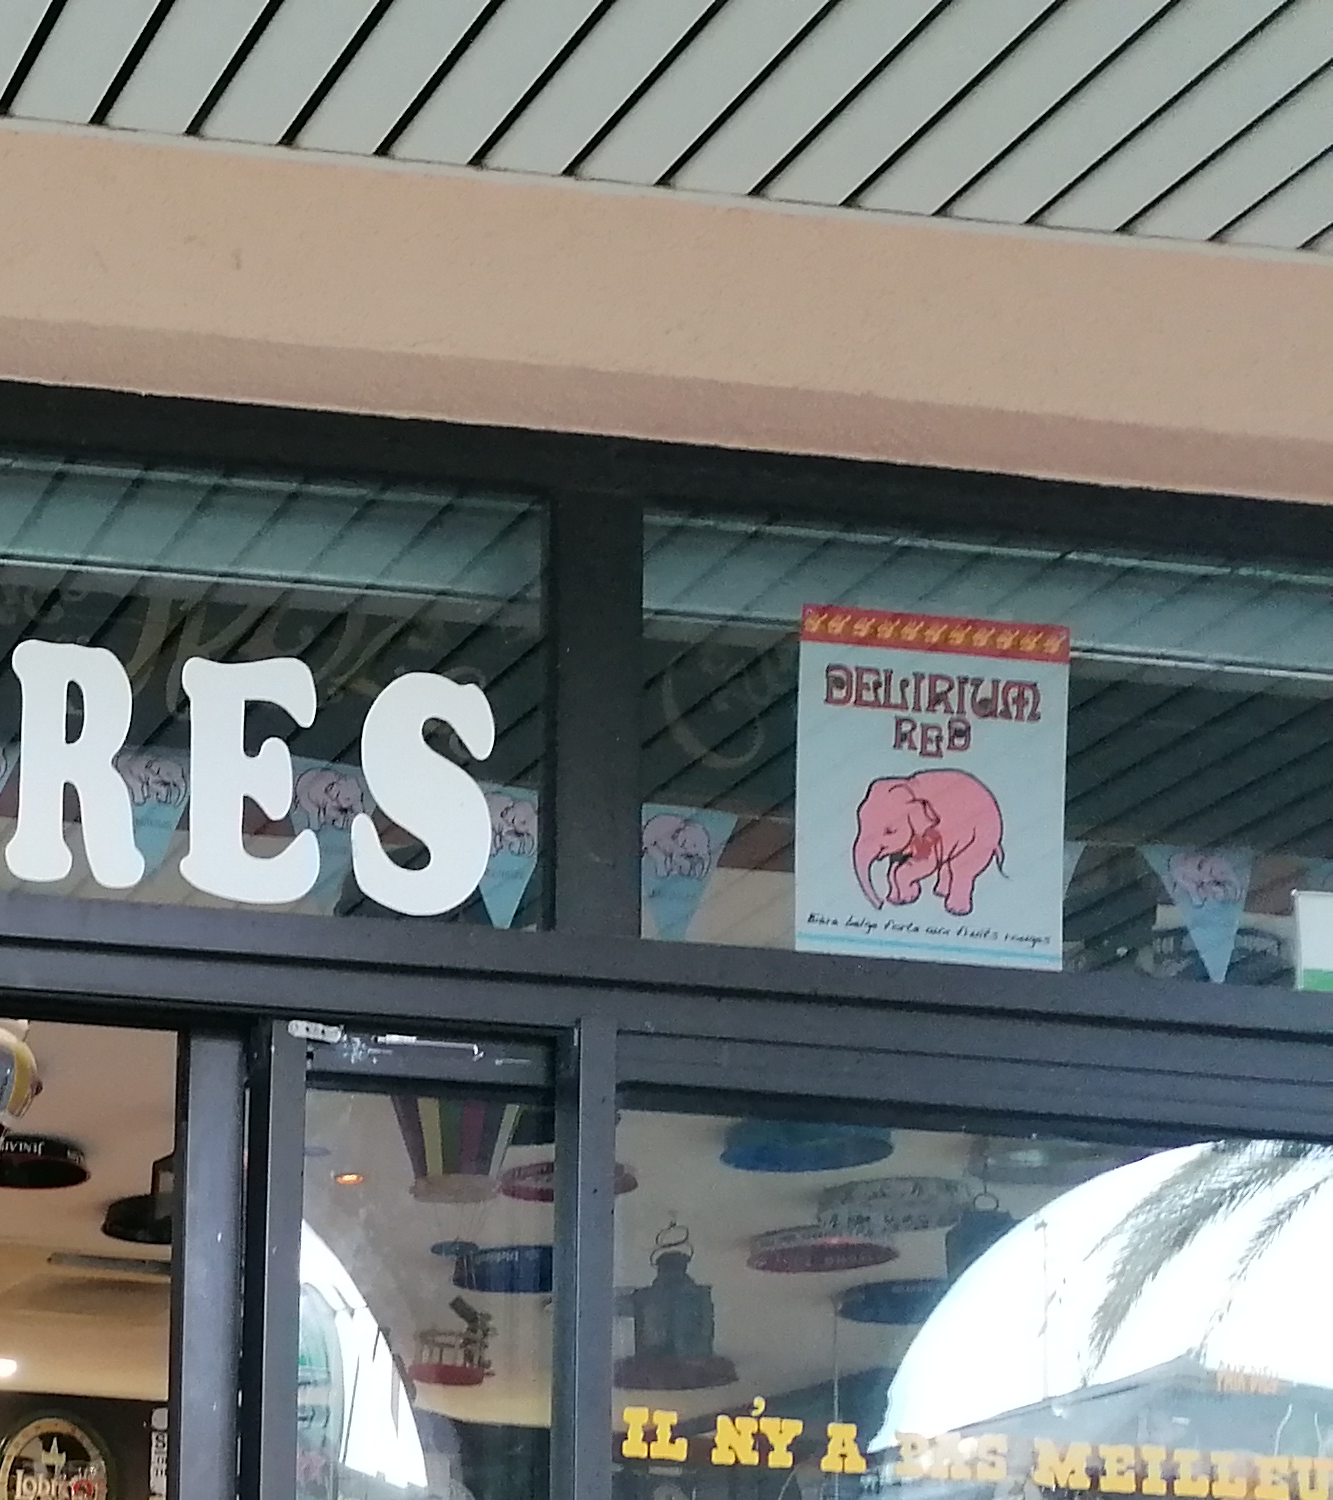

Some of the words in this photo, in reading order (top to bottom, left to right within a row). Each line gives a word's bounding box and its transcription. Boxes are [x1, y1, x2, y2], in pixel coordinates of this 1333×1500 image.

[824, 664, 1041, 722] DELIRIUM
[893, 717, 971, 758] RED
[623, 1407, 688, 1463] IL
[711, 1396, 804, 1469] N'Y
[821, 1423, 868, 1473] A
[895, 1431, 1009, 1482] PAS
